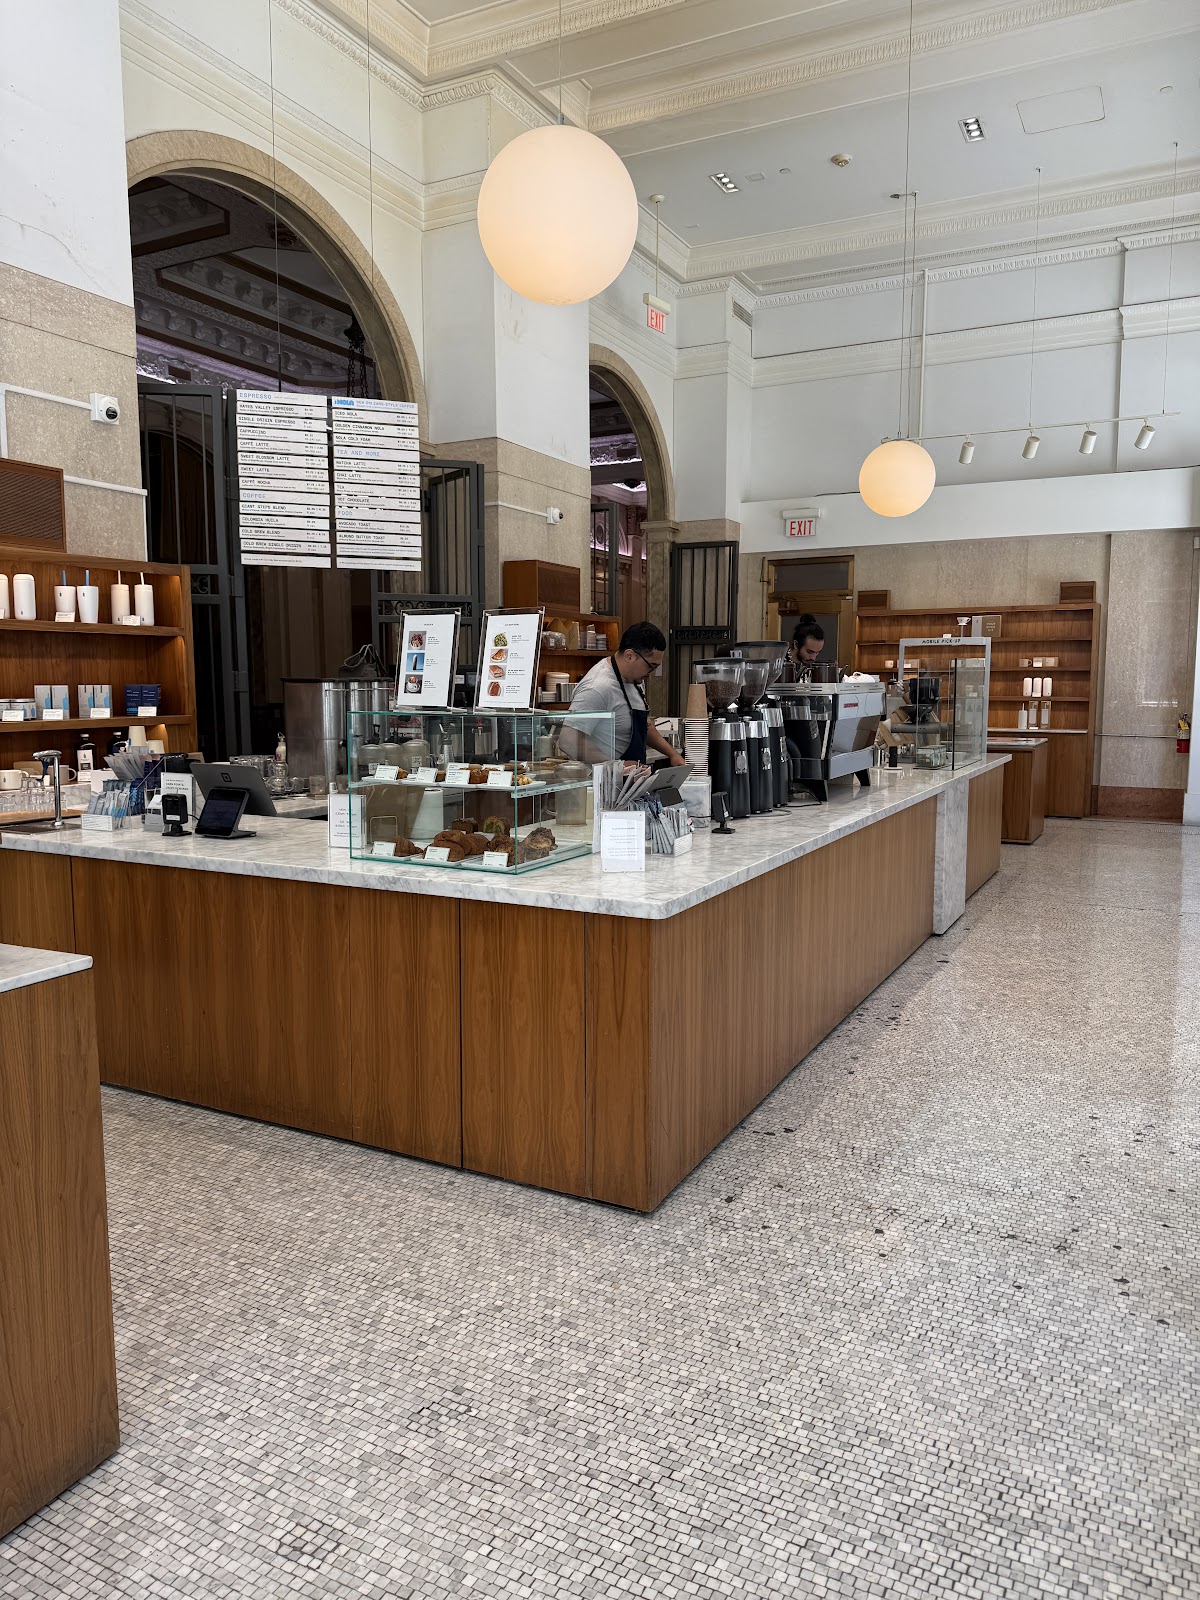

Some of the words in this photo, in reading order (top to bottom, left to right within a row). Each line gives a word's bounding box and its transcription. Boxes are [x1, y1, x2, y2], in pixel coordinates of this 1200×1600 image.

[650, 309, 665, 332] EXIT
[239, 392, 272, 400] ESPRESSO
[790, 520, 814, 536] EXIT
